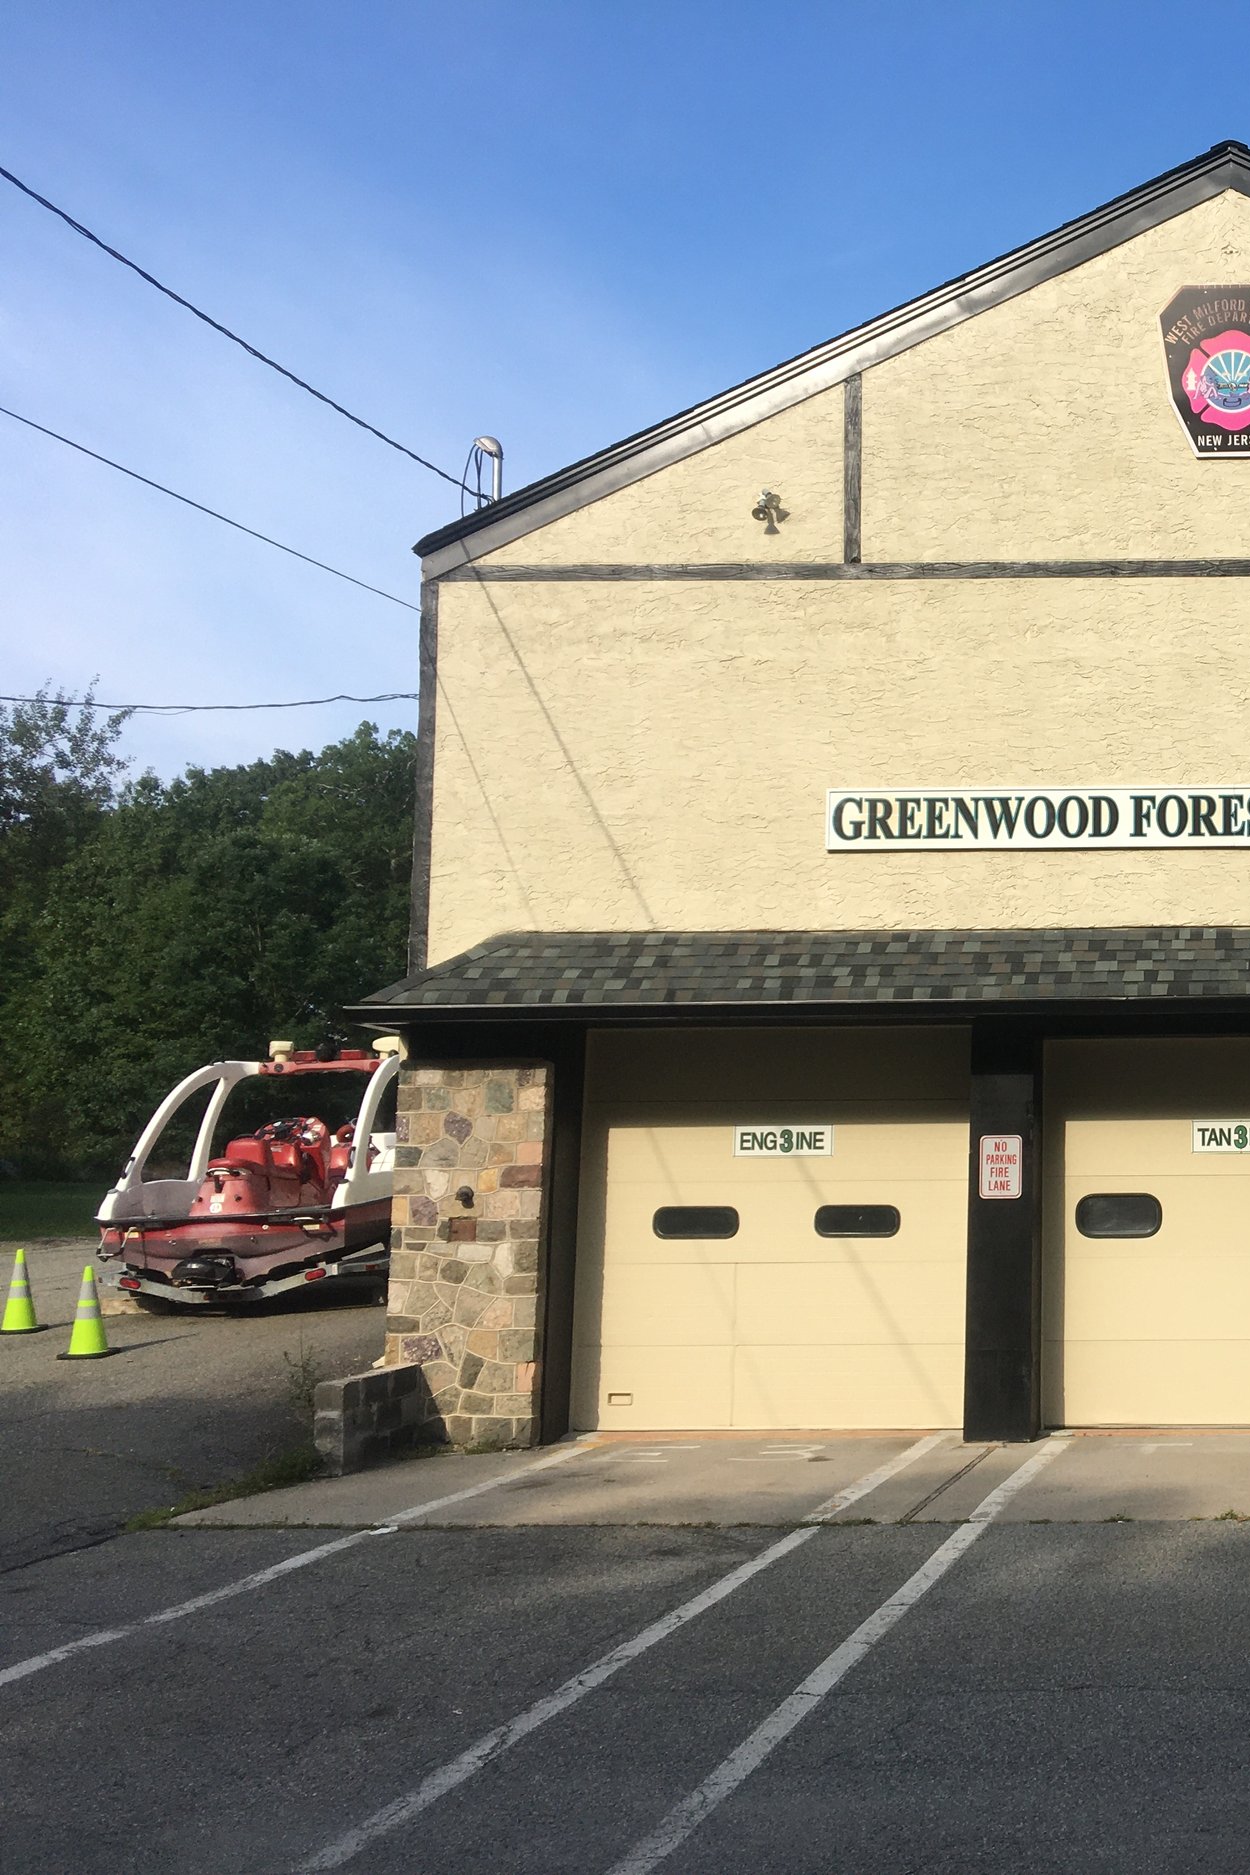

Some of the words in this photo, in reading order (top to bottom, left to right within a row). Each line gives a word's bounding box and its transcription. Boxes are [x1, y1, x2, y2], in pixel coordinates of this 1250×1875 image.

[1164, 315, 1192, 344] WEST
[1192, 298, 1246, 321] MILFORD
[1181, 321, 1207, 345] FIRE
[1197, 435, 1222, 447] NEW
[831, 795, 1120, 841] GREENWOOD
[994, 1141, 1008, 1152] NO
[986, 1154, 1017, 1165] PARKING
[990, 1167, 1010, 1178] FIRE
[988, 1180, 1011, 1191] LANE
